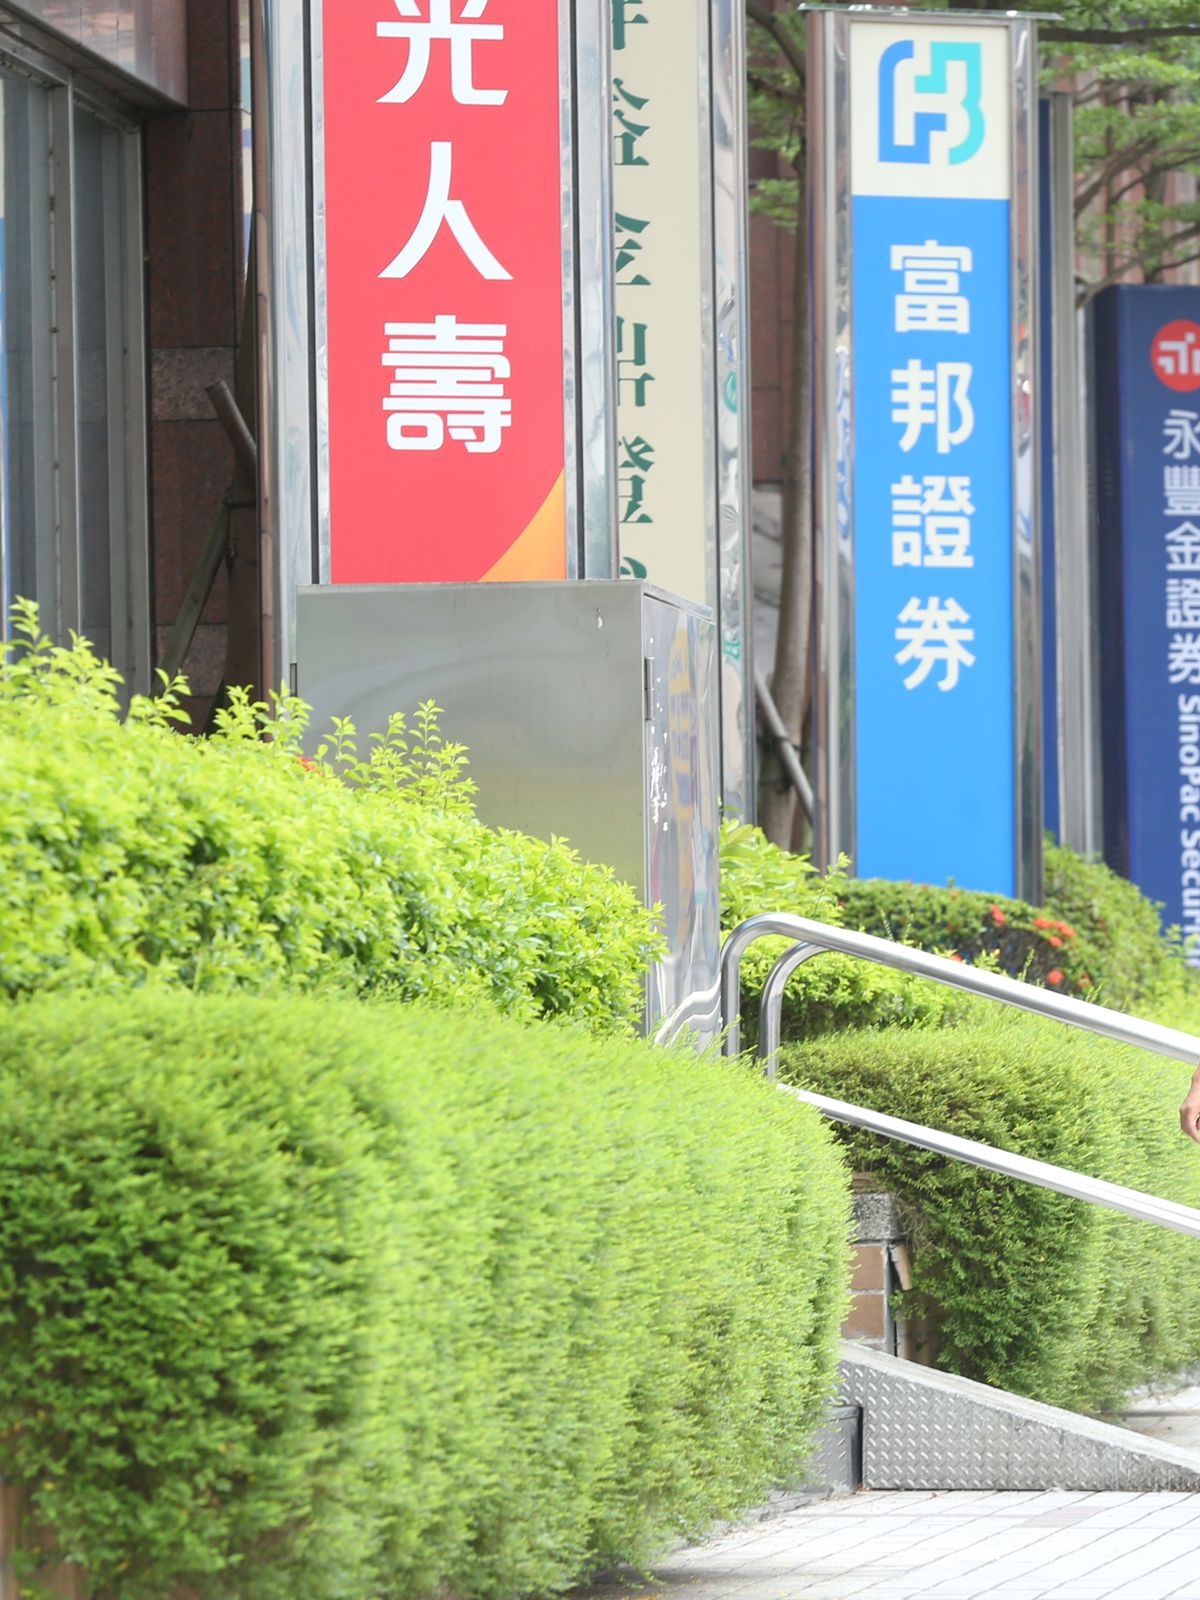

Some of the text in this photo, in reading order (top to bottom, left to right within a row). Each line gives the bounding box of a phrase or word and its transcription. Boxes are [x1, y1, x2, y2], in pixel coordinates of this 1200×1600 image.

[375, 0, 514, 454] 光人壽
[890, 240, 976, 692] 富邦證券
